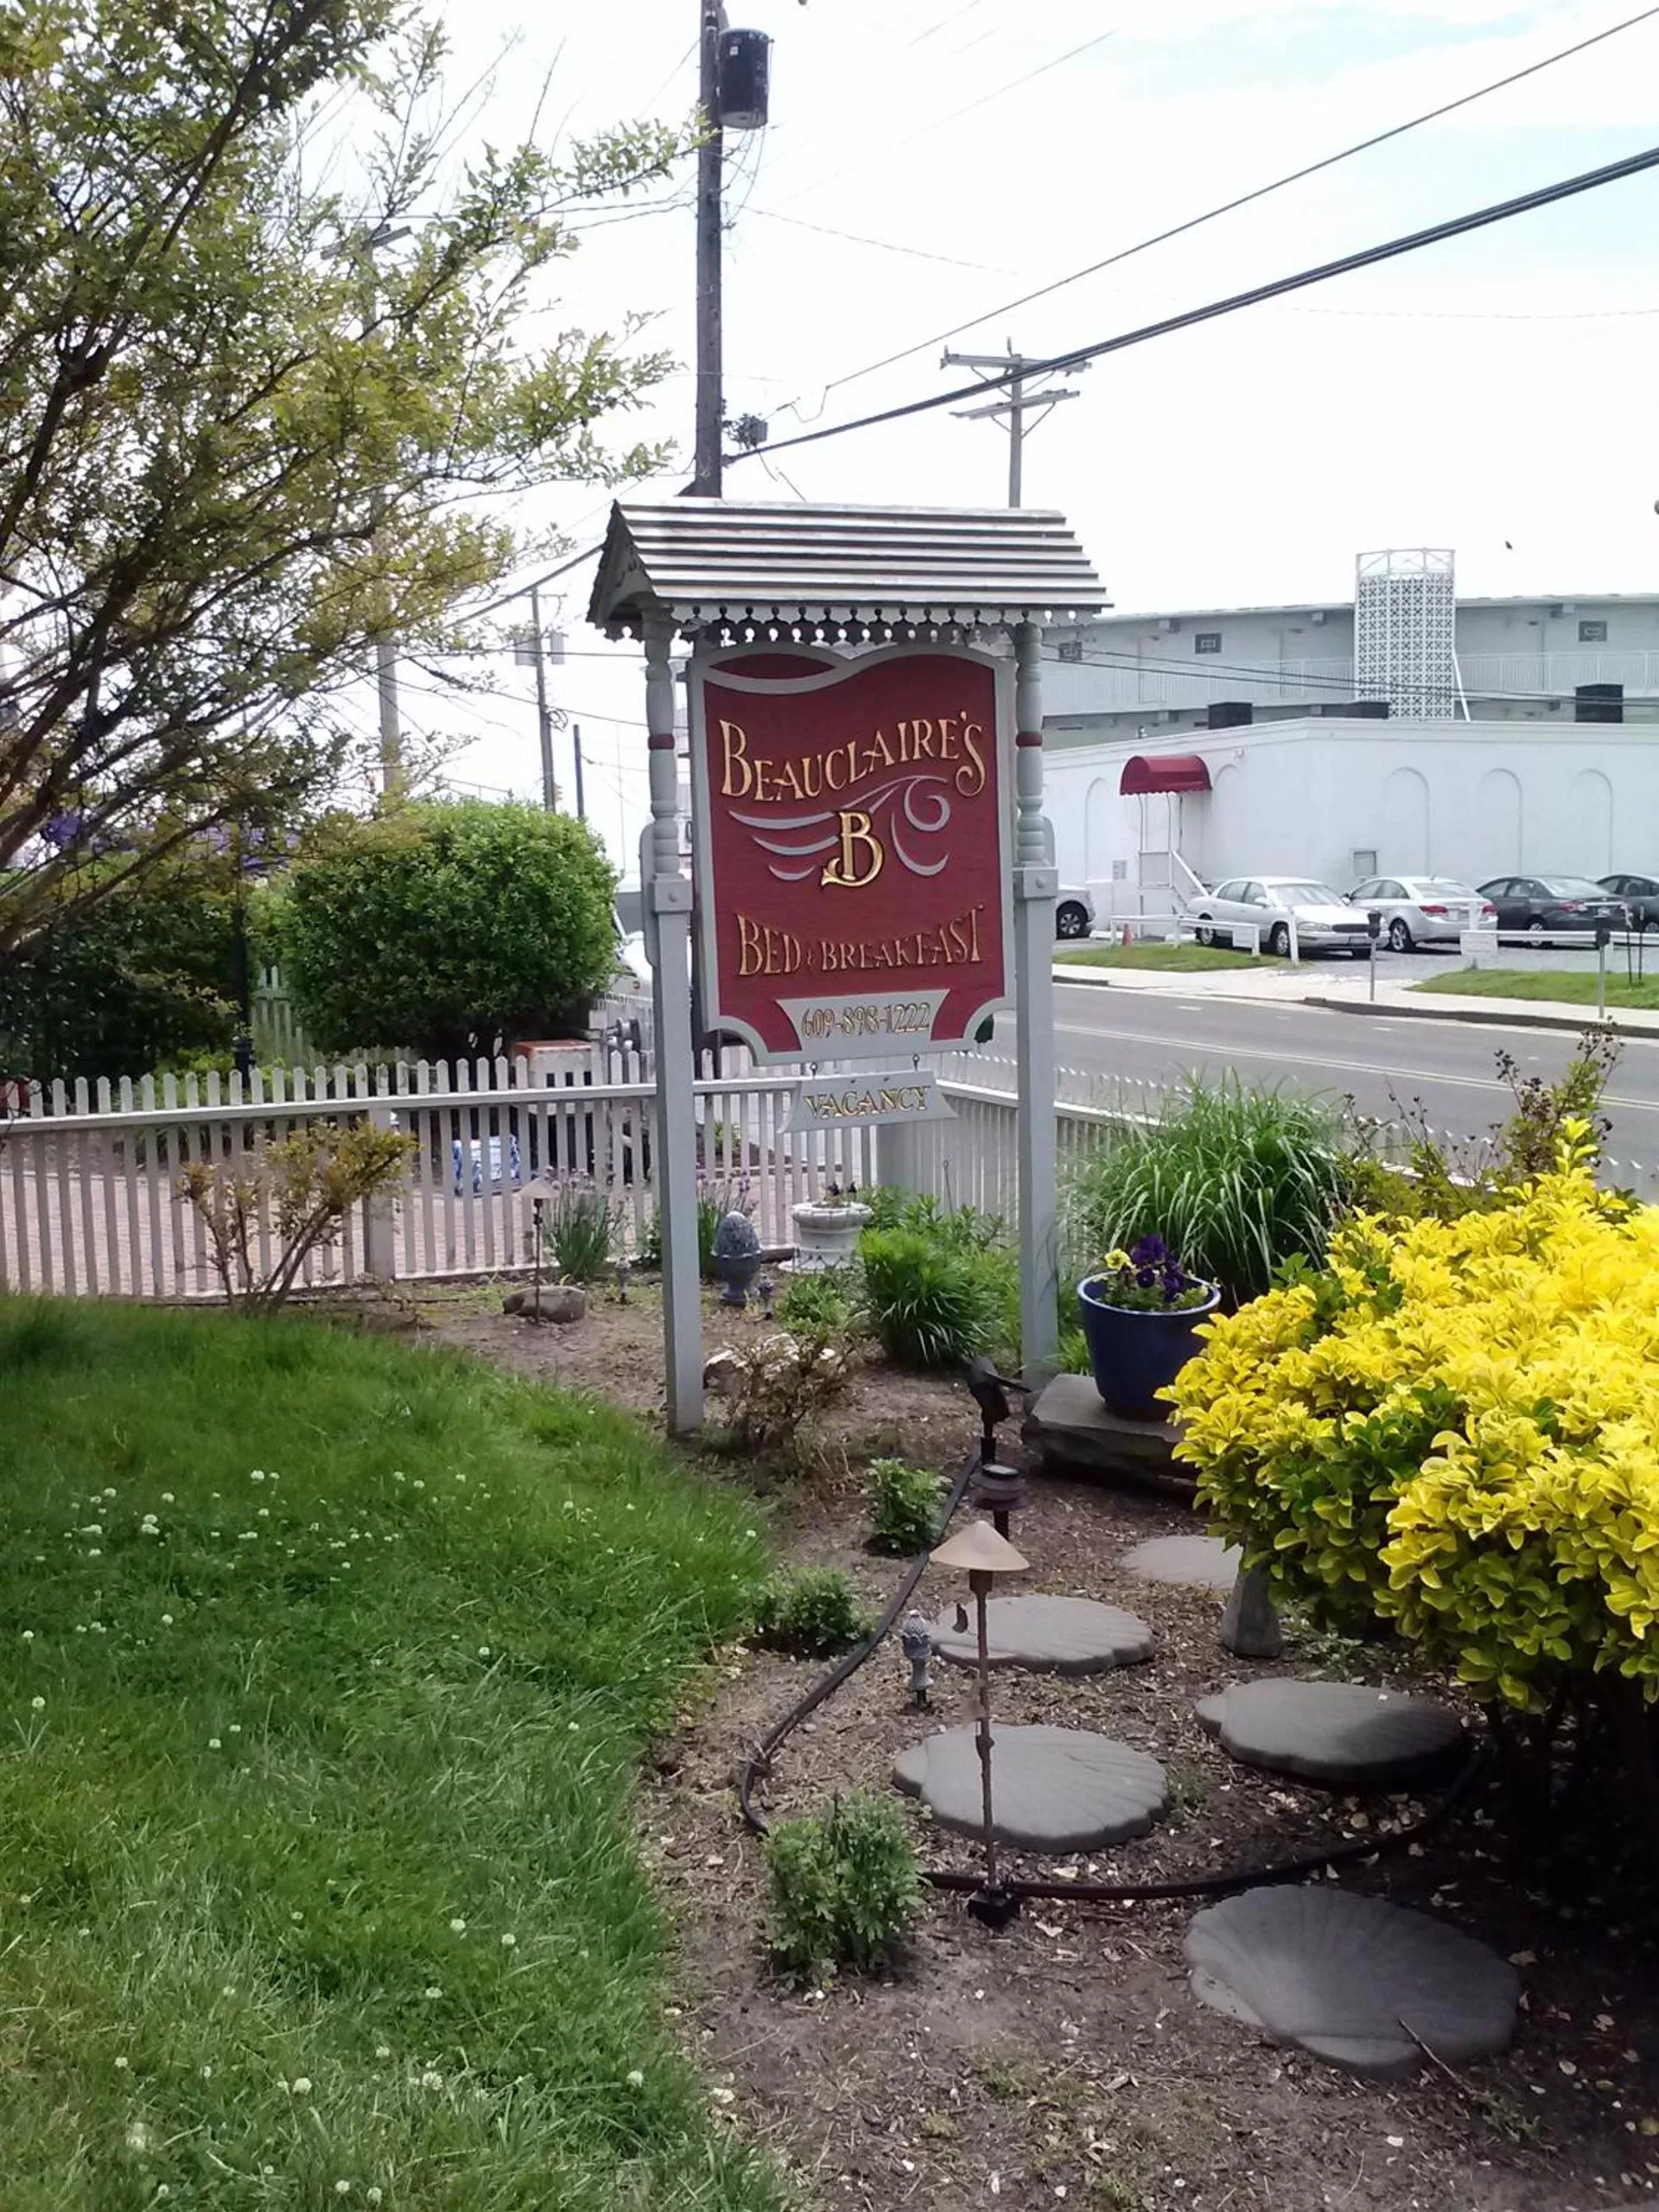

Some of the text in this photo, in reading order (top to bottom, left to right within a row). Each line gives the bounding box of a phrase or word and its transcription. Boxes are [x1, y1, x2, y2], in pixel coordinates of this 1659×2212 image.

[719, 710, 986, 802] BEAUCLAIRE'S
[820, 810, 884, 887] B
[734, 904, 983, 976] BED BREAKFAST
[801, 1001, 931, 1039] 609-898-1222
[802, 1084, 931, 1120] VACANCY
